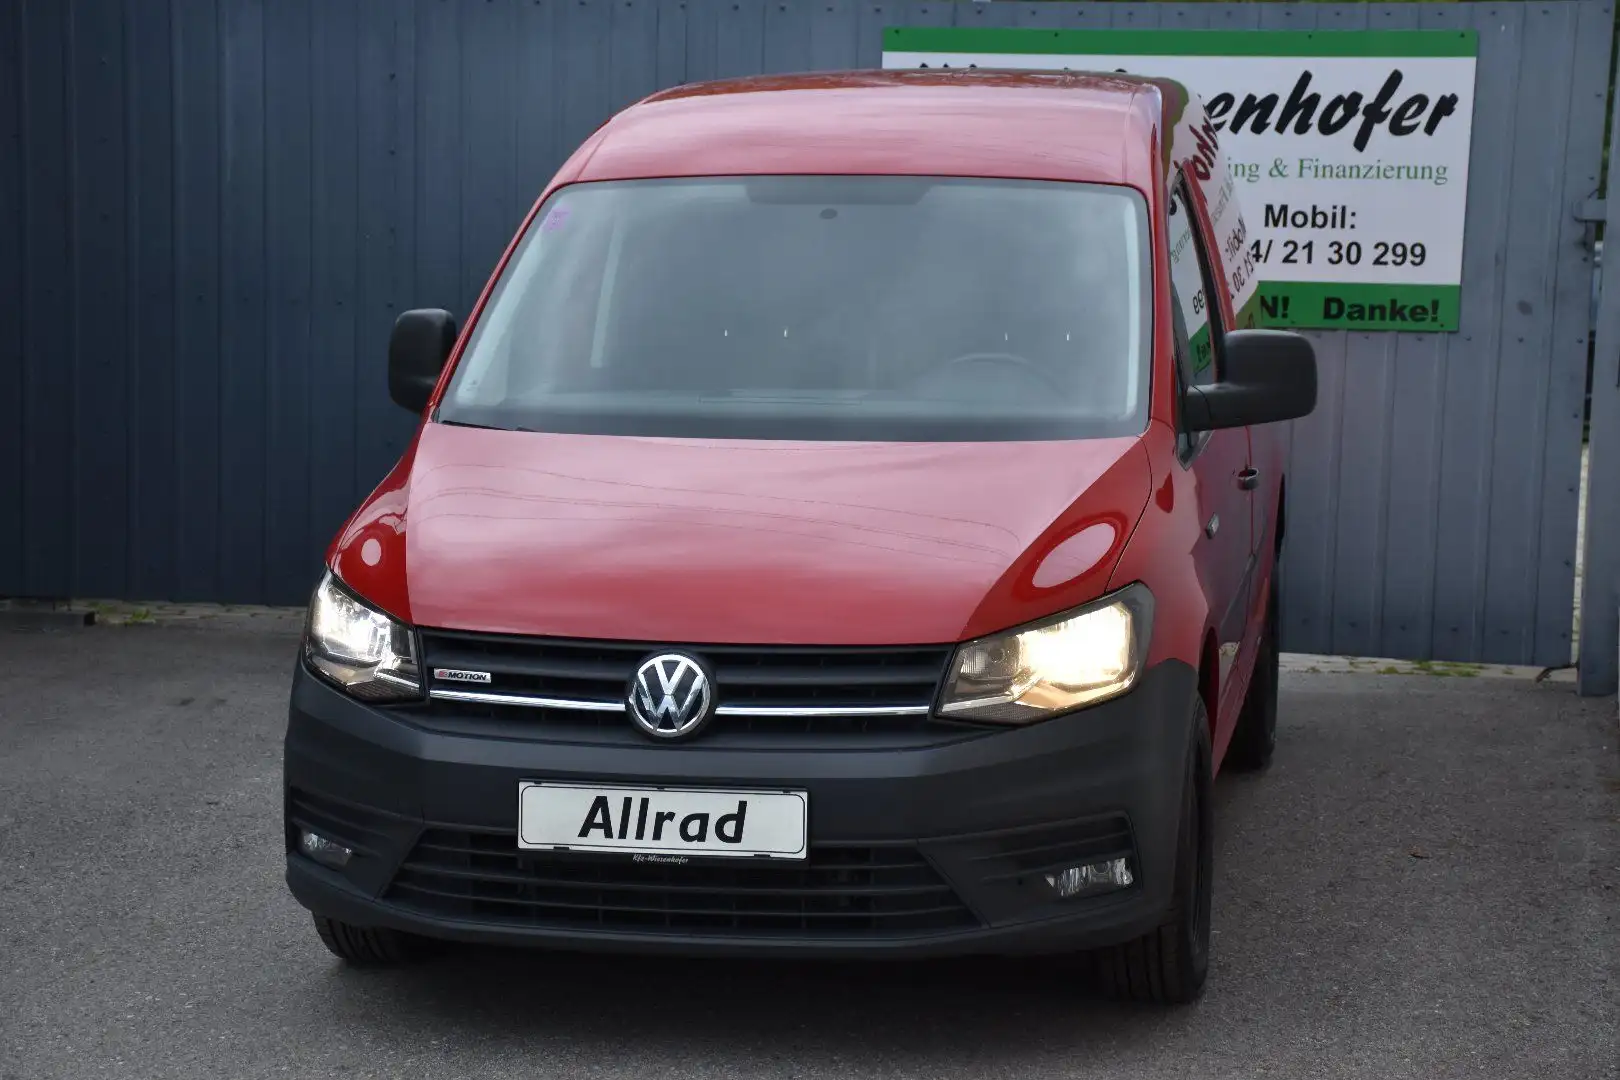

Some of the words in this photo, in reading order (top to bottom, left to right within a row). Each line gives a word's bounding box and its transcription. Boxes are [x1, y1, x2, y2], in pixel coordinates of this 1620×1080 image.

[1206, 69, 1459, 153] enhofer
[1227, 156, 1260, 183] ing
[1269, 157, 1290, 178] &
[1298, 158, 1449, 186] Finanzierung
[1264, 204, 1357, 230] Mobil:
[1250, 239, 1274, 264] 4/
[1282, 240, 1314, 264] 21
[1327, 241, 1362, 265] 30
[1372, 241, 1427, 267] 299
[1259, 295, 1290, 319] N!
[1323, 296, 1440, 322] Danke!
[630, 654, 711, 737] VW
[577, 795, 748, 844] Allrad
